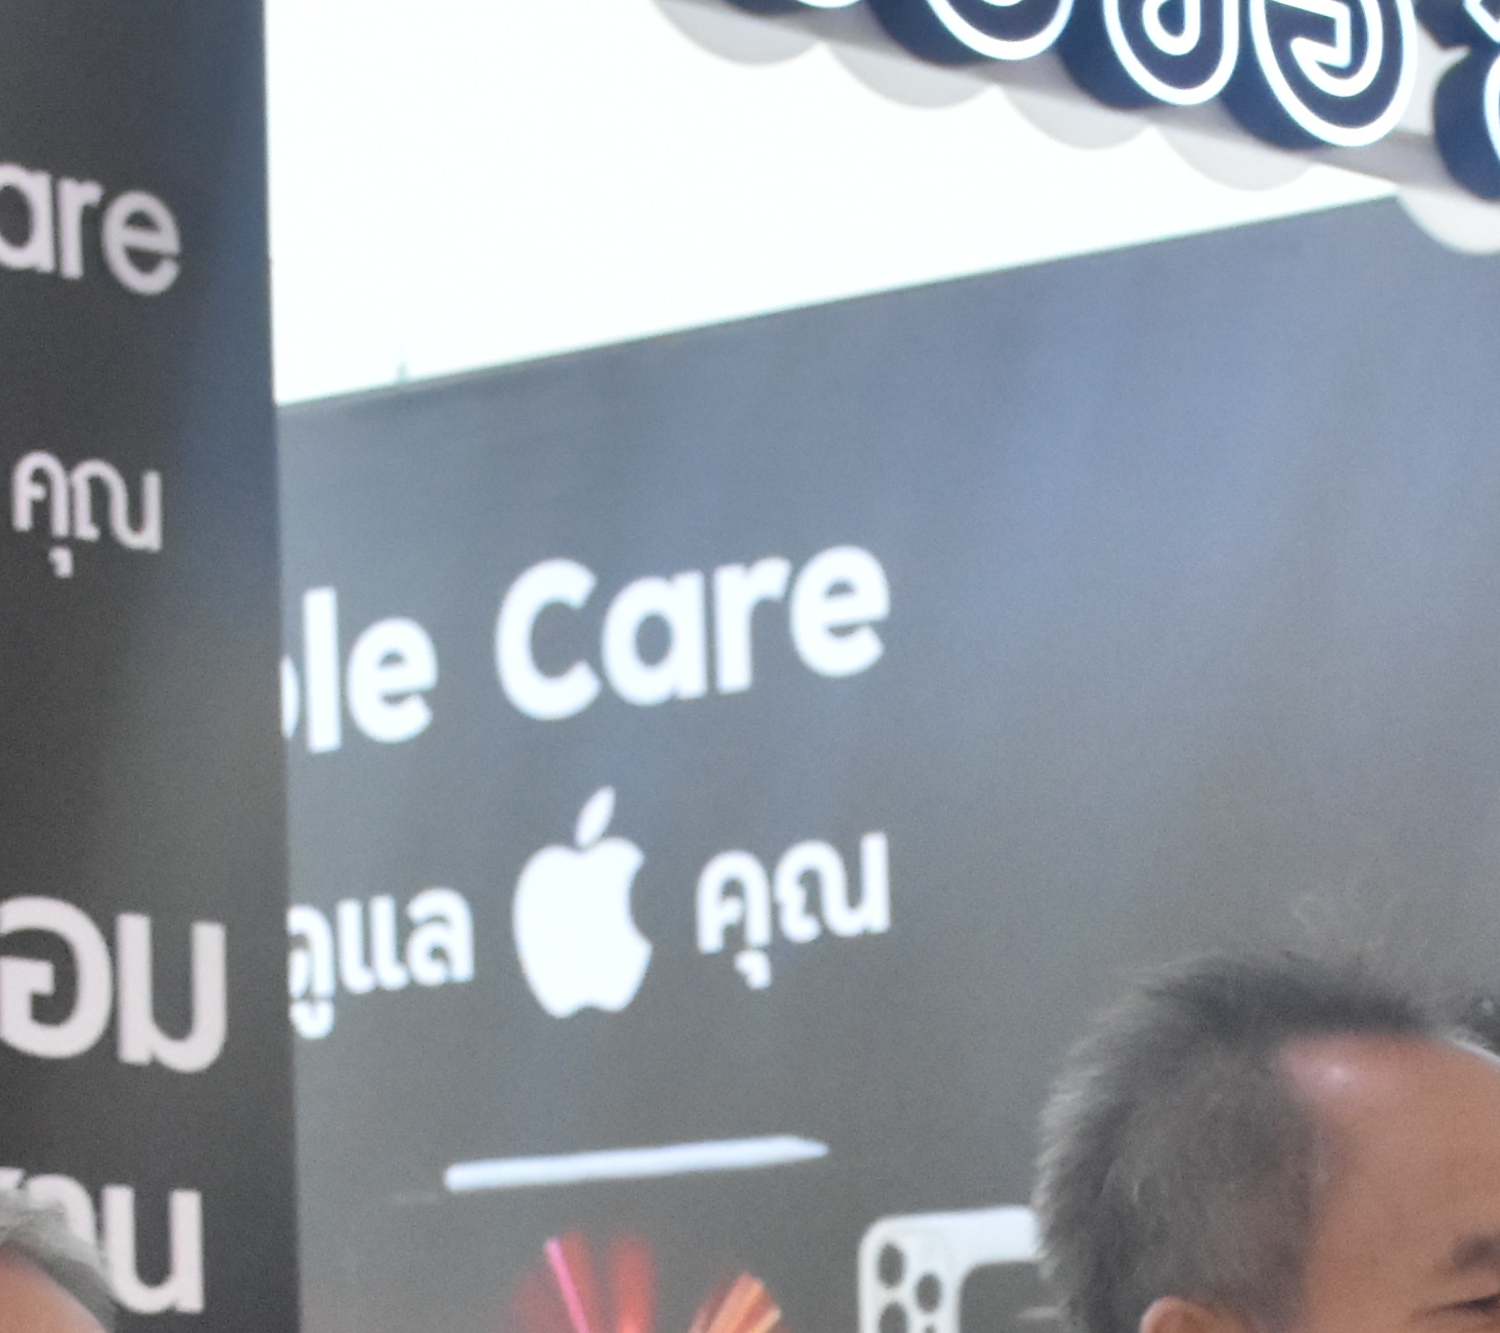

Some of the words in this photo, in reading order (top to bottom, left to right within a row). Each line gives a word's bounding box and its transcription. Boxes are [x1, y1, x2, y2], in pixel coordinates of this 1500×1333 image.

[12, 451, 161, 578] คุณ
[282, 586, 438, 753] le
[494, 545, 890, 721] Care
[696, 831, 890, 989] คุณ
